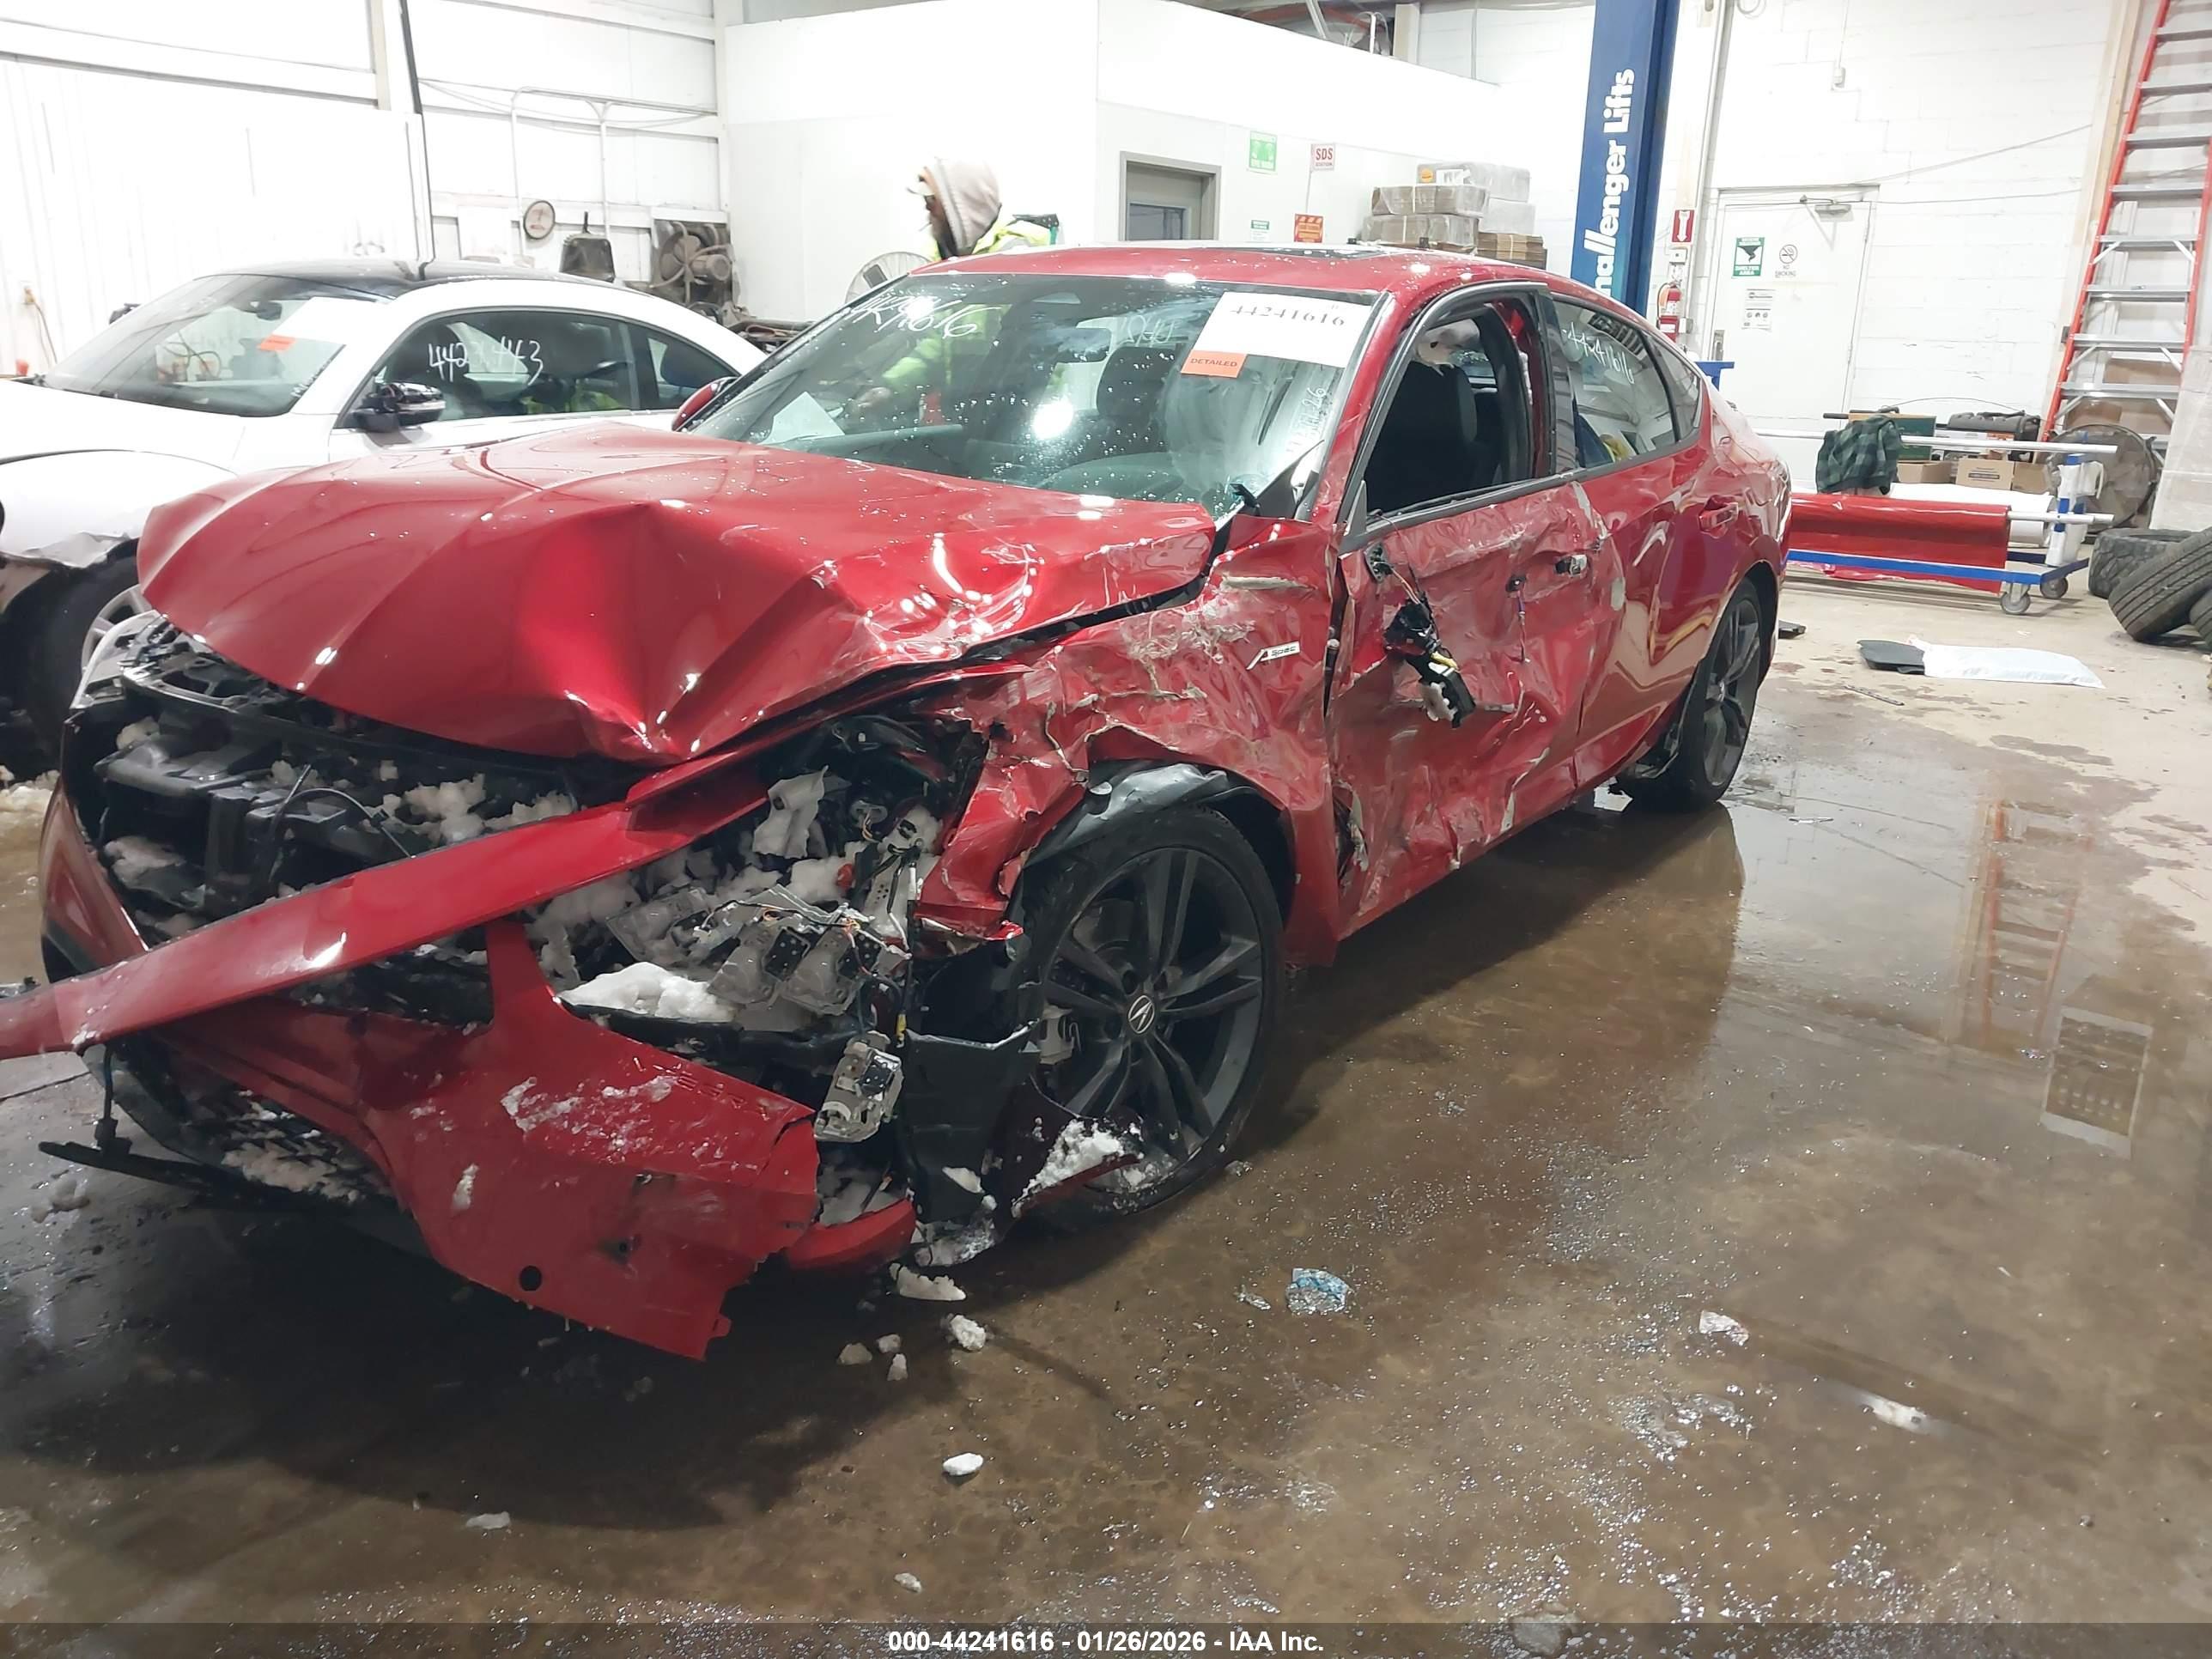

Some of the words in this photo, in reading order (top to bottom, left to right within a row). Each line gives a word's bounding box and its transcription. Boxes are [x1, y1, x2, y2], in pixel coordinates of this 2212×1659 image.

[1603, 69, 1635, 133] Lifts
[1316, 148, 1334, 161] SDS
[1230, 305, 1345, 326] 44241616
[1190, 357, 1237, 368] DETAILED
